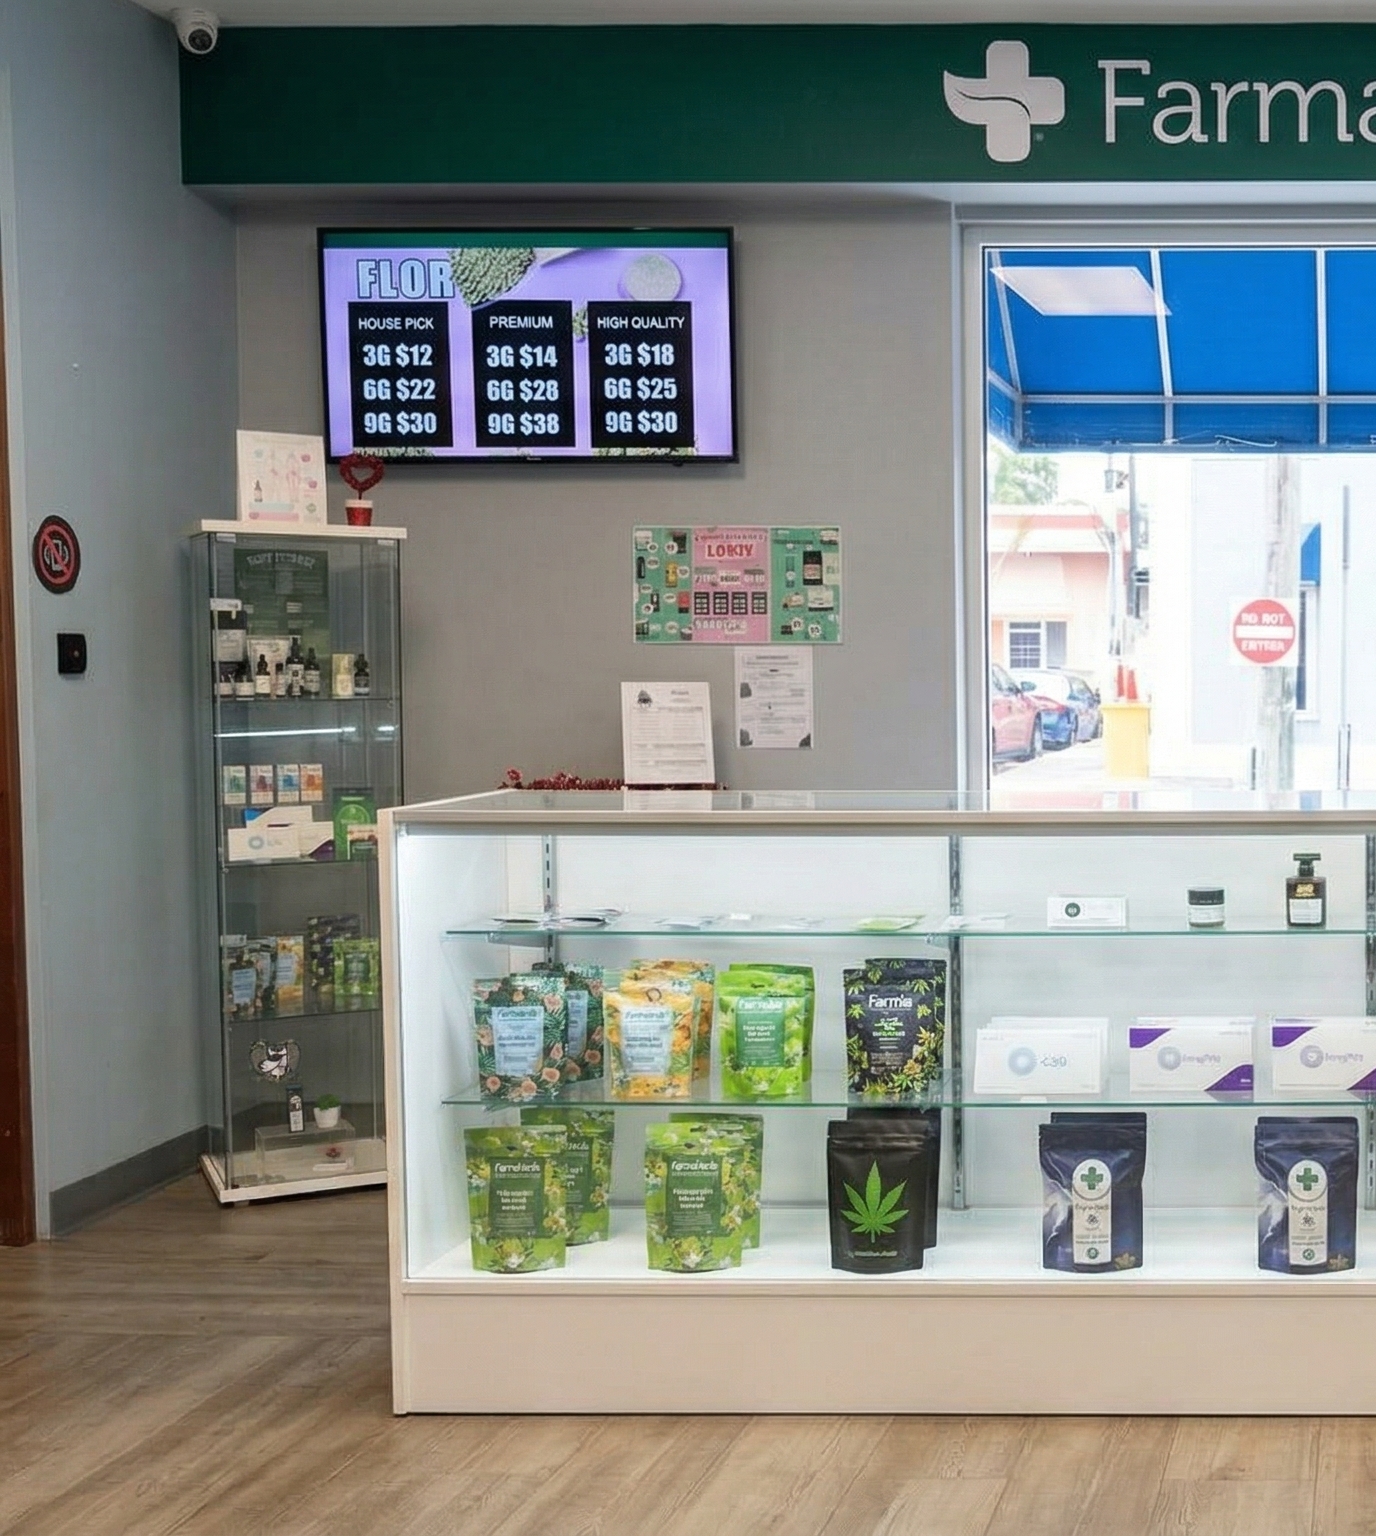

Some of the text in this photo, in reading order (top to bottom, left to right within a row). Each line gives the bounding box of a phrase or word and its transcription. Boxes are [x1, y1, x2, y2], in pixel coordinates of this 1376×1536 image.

[357, 258, 455, 299] FLOR
[358, 317, 435, 330] HOUSE PICK
[489, 315, 554, 329] PREMIUM
[596, 316, 686, 330] HIGH QUALITY
[363, 343, 433, 368] 3G $12
[486, 344, 558, 369] 3G $14
[605, 342, 675, 367] 3G $18
[364, 378, 436, 402] 6G $22
[487, 379, 559, 403] 6G $28
[604, 377, 678, 401] 6G $25
[364, 411, 437, 435] 9G $30
[488, 411, 560, 436] 9G $38
[605, 410, 678, 434] 9G $30
